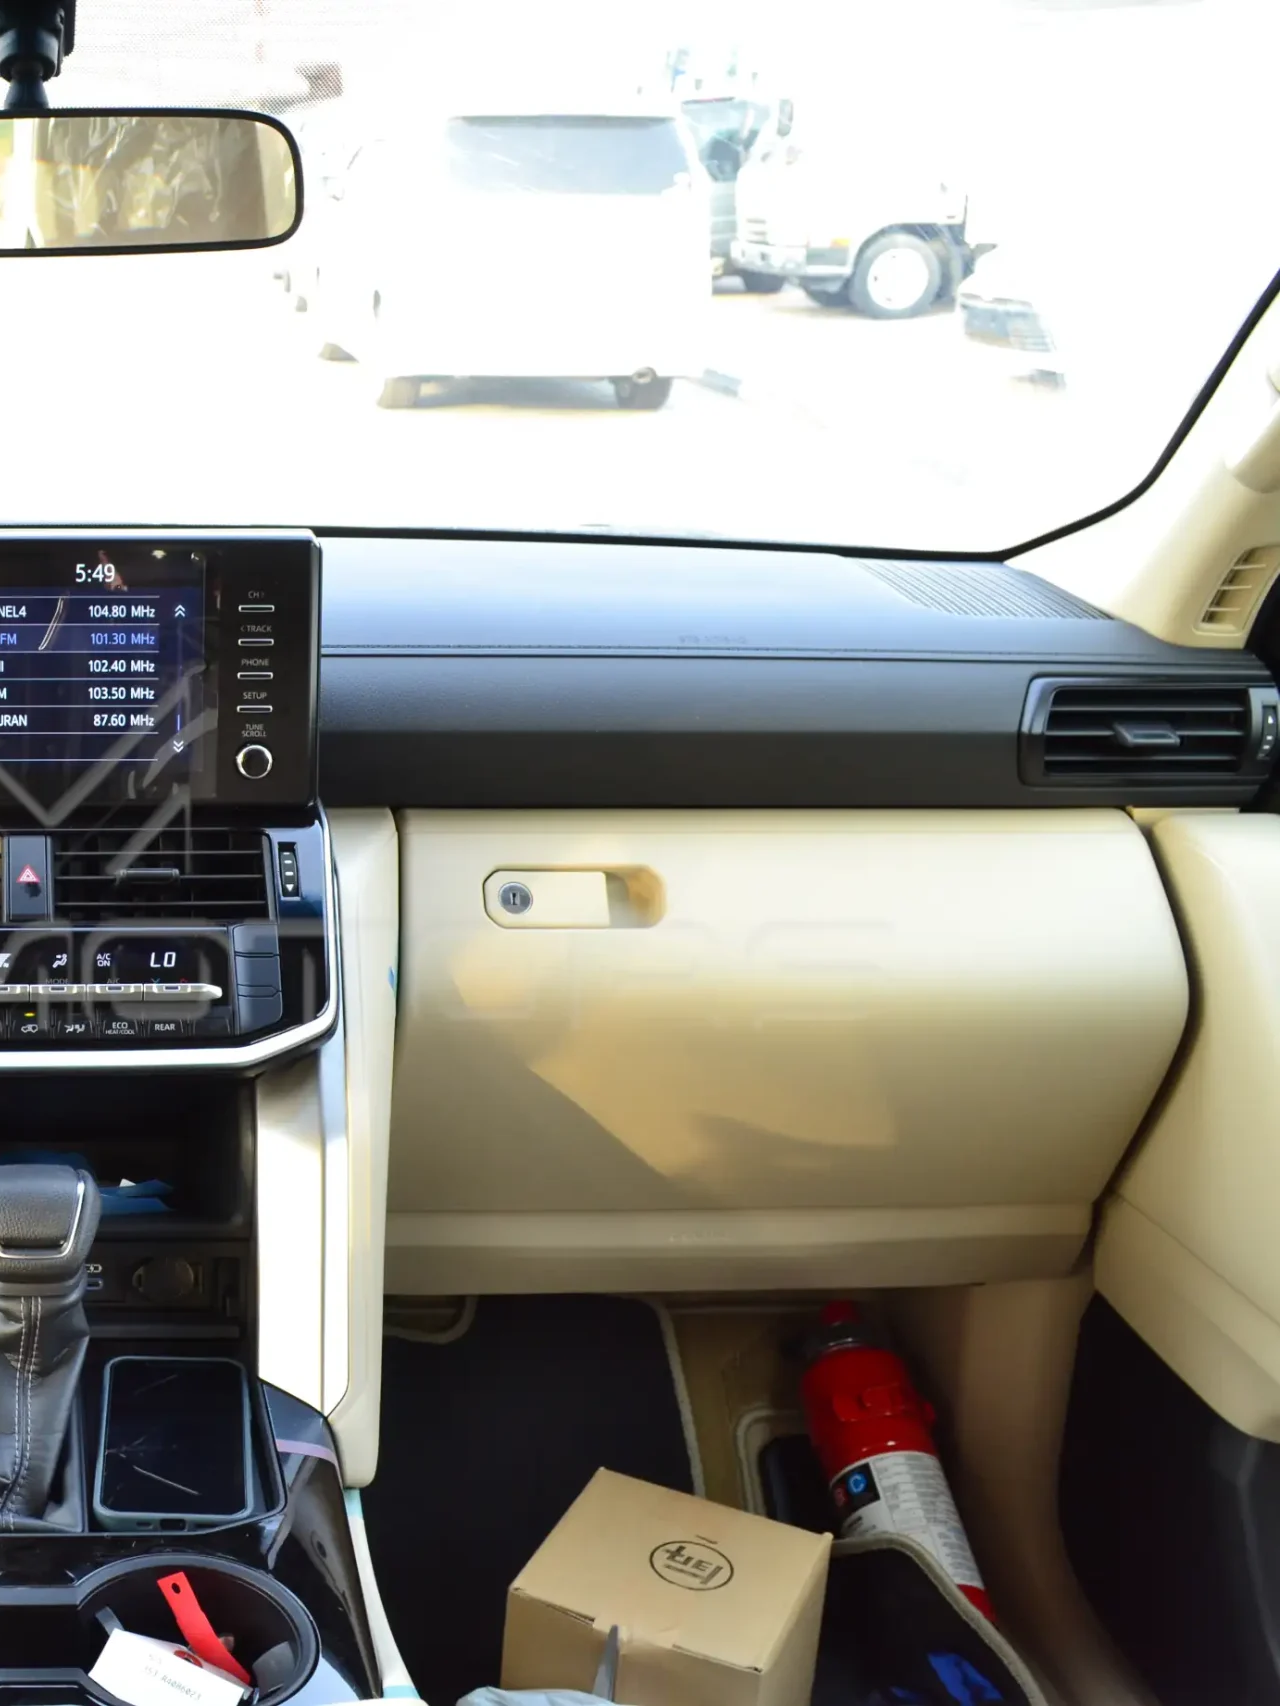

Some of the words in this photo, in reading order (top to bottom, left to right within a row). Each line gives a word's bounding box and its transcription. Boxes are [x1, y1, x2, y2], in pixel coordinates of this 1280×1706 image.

[74, 563, 116, 583] 5:49
[88, 605, 127, 618] 104.80
[131, 605, 155, 618] MHz
[247, 625, 272, 633] TRACK
[0, 633, 17, 645] FM
[90, 633, 126, 645] 101.30
[131, 633, 155, 645] MHz
[88, 660, 126, 673] 102.40
[130, 660, 155, 673] MHz
[241, 658, 269, 666] PHONE
[88, 687, 126, 699] 103.50
[130, 687, 155, 699] MHz
[242, 692, 268, 700] SETUP
[93, 714, 126, 727] 87.60
[130, 714, 155, 727] MHz
[96, 953, 111, 961] A/C
[154, 1023, 176, 1031] REAR
